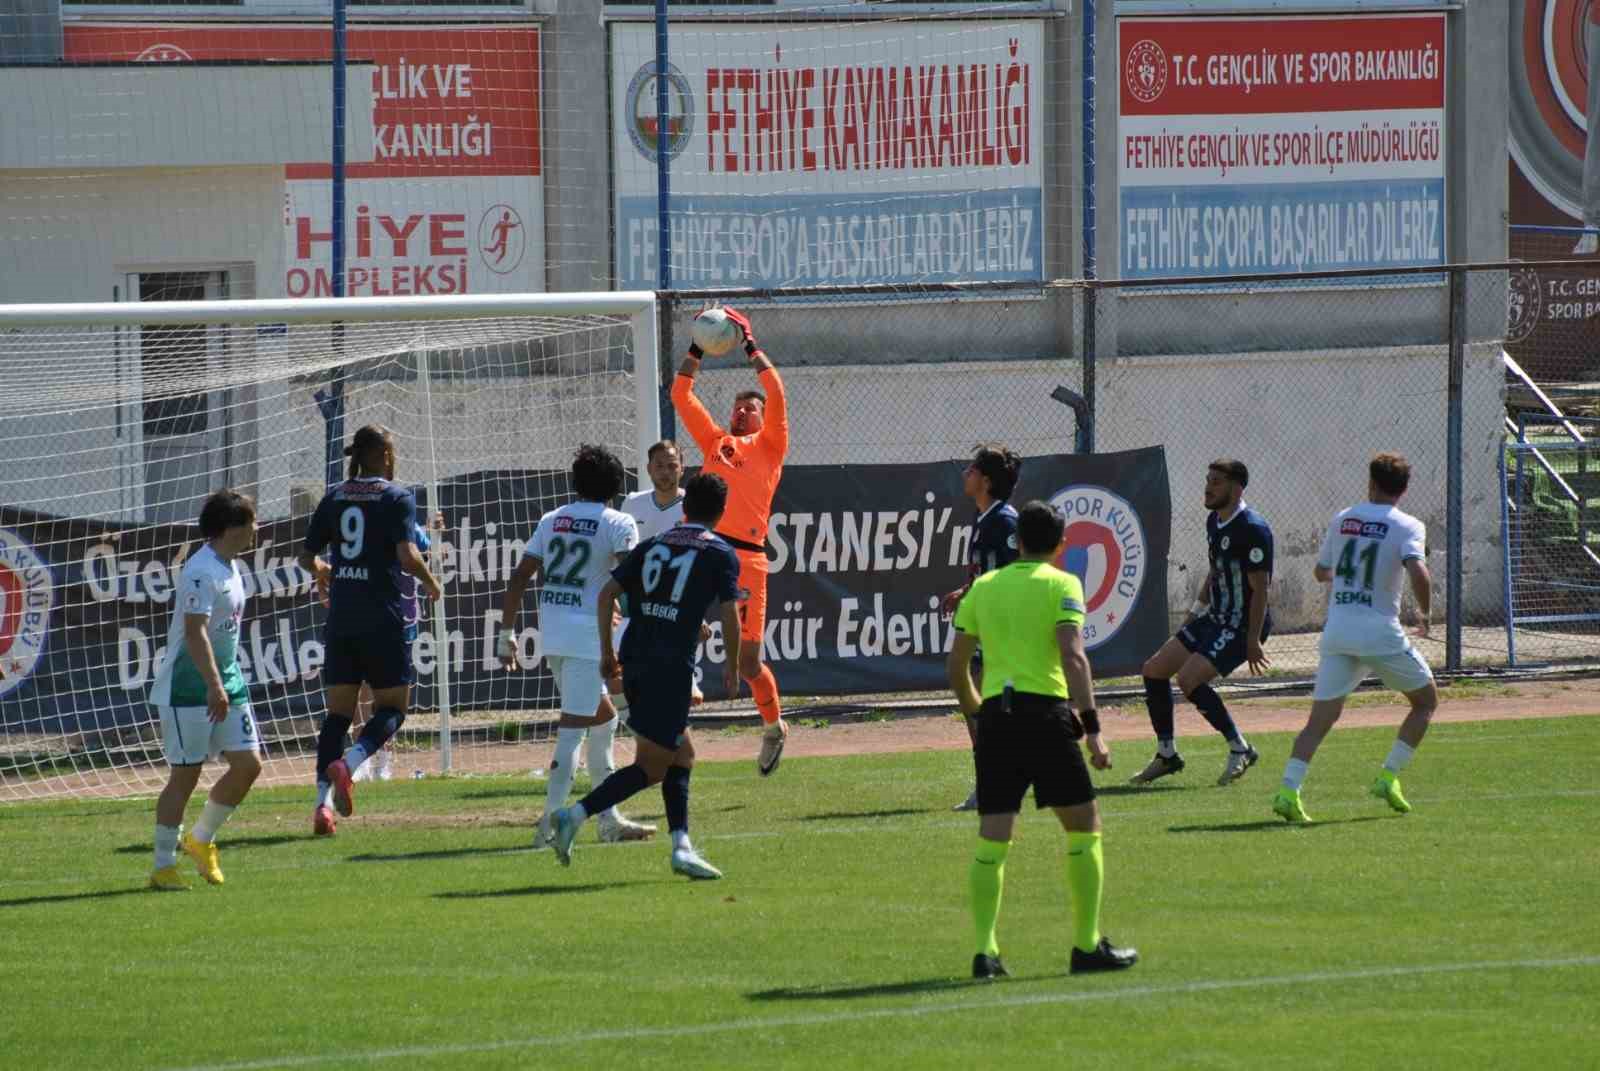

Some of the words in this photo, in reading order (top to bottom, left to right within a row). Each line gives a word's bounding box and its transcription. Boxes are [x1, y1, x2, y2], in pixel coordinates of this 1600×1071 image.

[432, 63, 473, 98] VE
[1172, 54, 1203, 86] T.C.
[1207, 48, 1277, 94] GENÇLİK
[1283, 54, 1304, 84] VE
[1309, 51, 1351, 84] SPOR
[1355, 41, 1440, 81] BAKANLIĞI
[706, 42, 816, 172] FETHİYE
[822, 38, 1029, 171] KAYMAKAMLIĞI
[1125, 127, 1185, 169] FETHİYE
[1187, 127, 1252, 177] GENÇLİK
[1252, 133, 1270, 168] VE
[1273, 131, 1311, 166] SPOR
[1314, 124, 1344, 174] İLÇE
[1347, 121, 1440, 163] MÜDÜRLÜĞÜ
[628, 203, 723, 281] FEHİYE
[728, 215, 810, 281] SPOR'A
[950, 194, 1034, 273] DİLERİZ
[1126, 192, 1200, 270] FETHİYE
[1202, 203, 1268, 269] SPOR'A
[1270, 201, 1370, 273] BAŞARILAR
[1373, 184, 1441, 262] DİLERİZ
[1547, 302, 1582, 320] SPOR
[1548, 280, 1573, 296] T.C.
[340, 505, 365, 560] 9
[544, 535, 591, 588] 22
[642, 543, 699, 603] 61
[1335, 537, 1380, 592] 41
